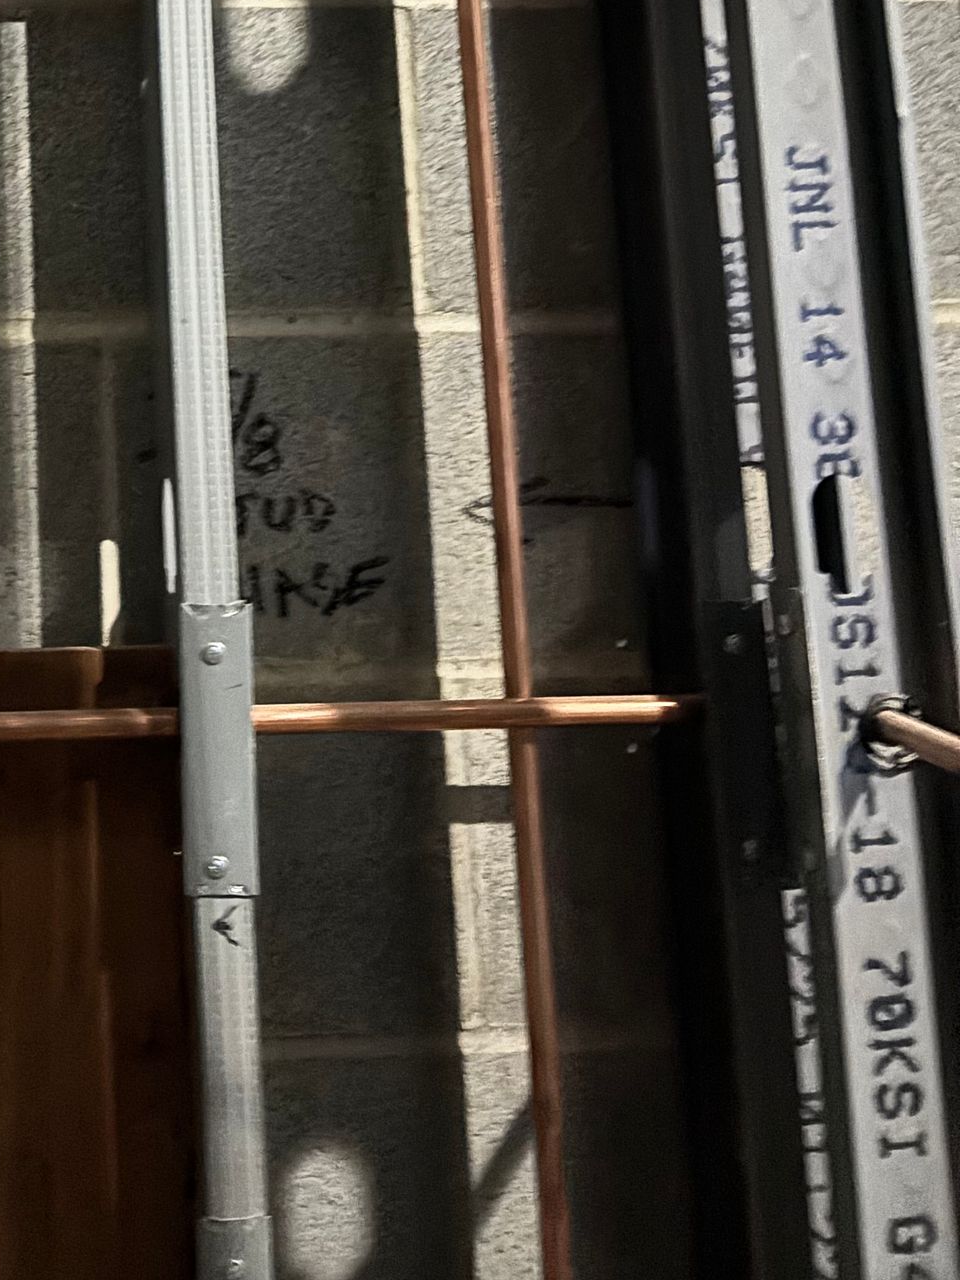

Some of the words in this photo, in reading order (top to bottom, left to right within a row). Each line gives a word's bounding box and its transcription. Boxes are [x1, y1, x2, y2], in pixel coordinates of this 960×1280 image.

[780, 146, 839, 251] JNL
[795, 300, 849, 368] 14
[859, 950, 932, 1160] 70KSI
